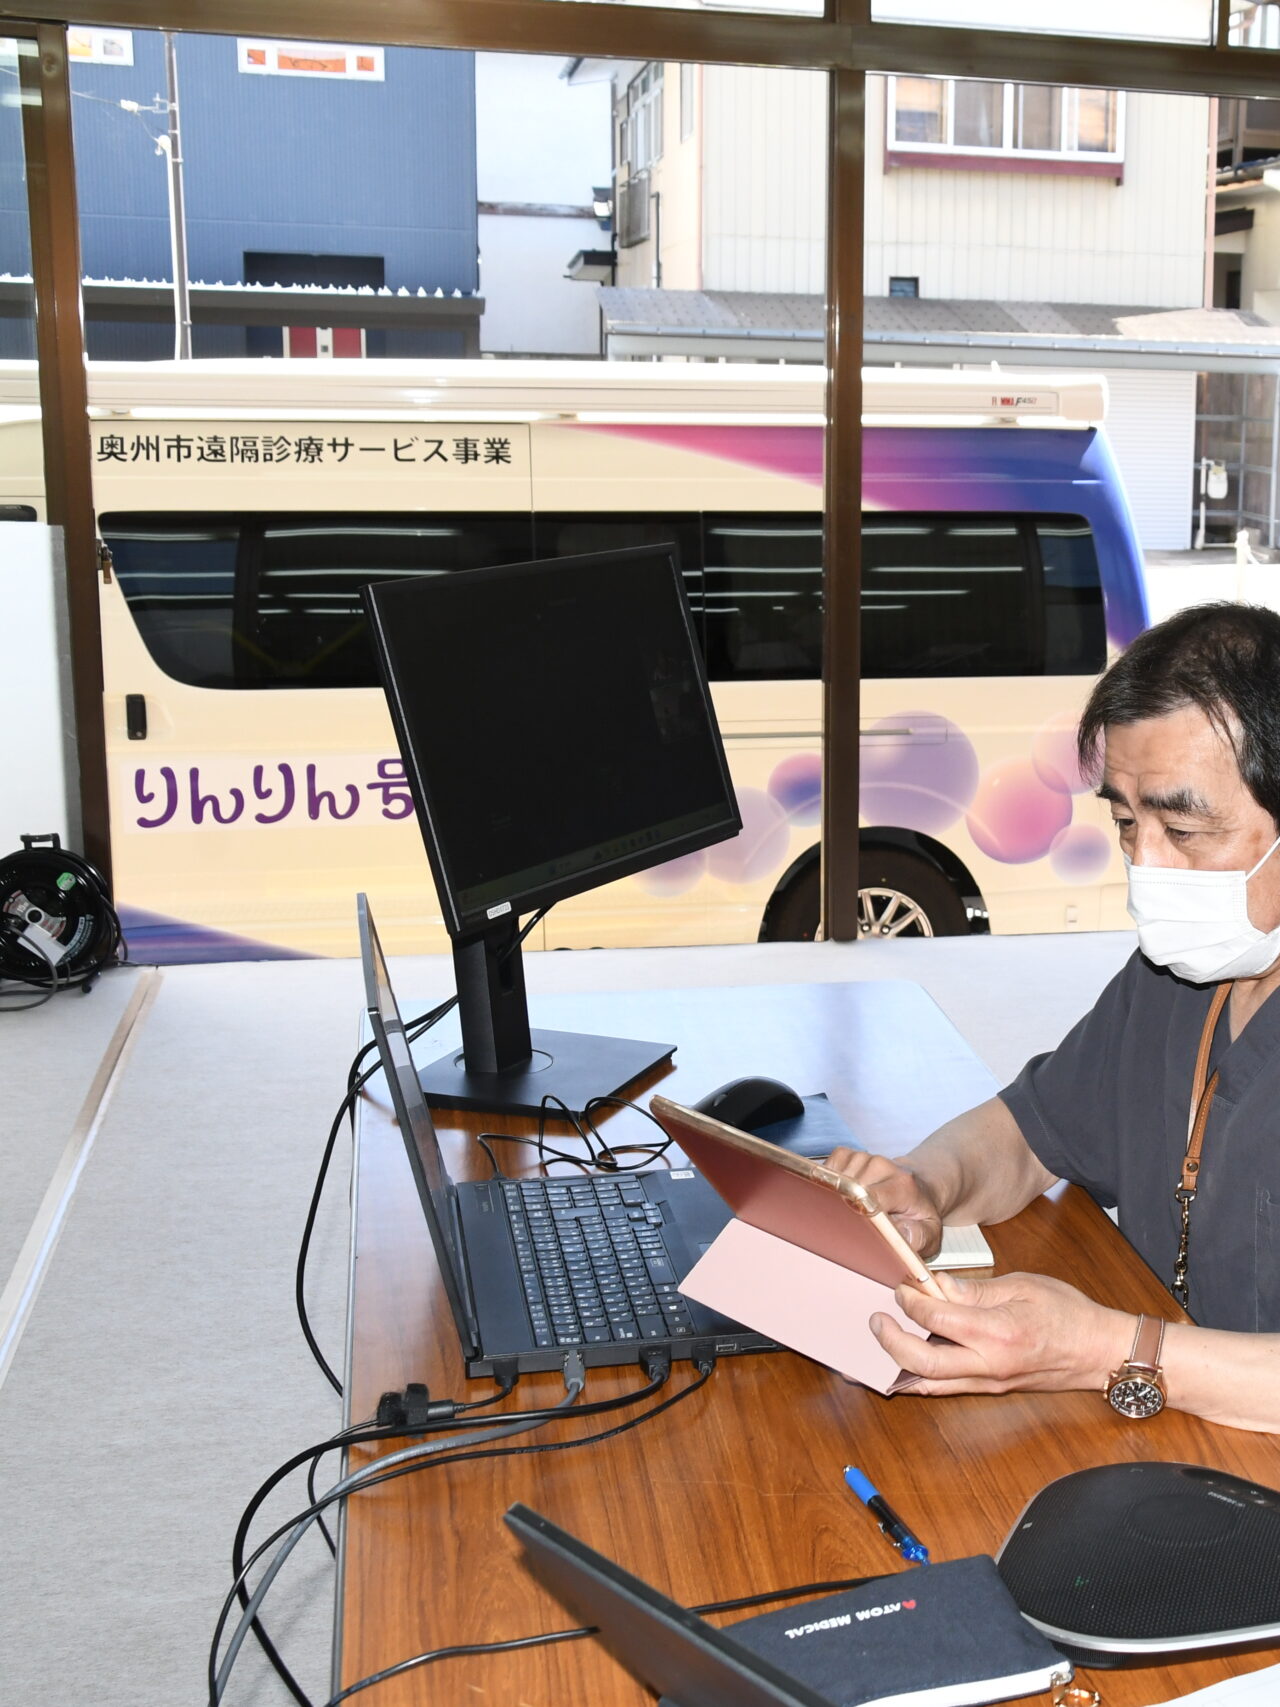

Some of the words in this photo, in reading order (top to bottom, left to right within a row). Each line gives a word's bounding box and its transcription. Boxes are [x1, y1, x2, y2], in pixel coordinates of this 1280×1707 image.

[97, 434, 512, 464] 奥州市遠隔診療サービス事業
[135, 758, 415, 828] りんりん号
[855, 1602, 901, 1621] ATOM
[784, 1613, 852, 1639] MEDICAL
